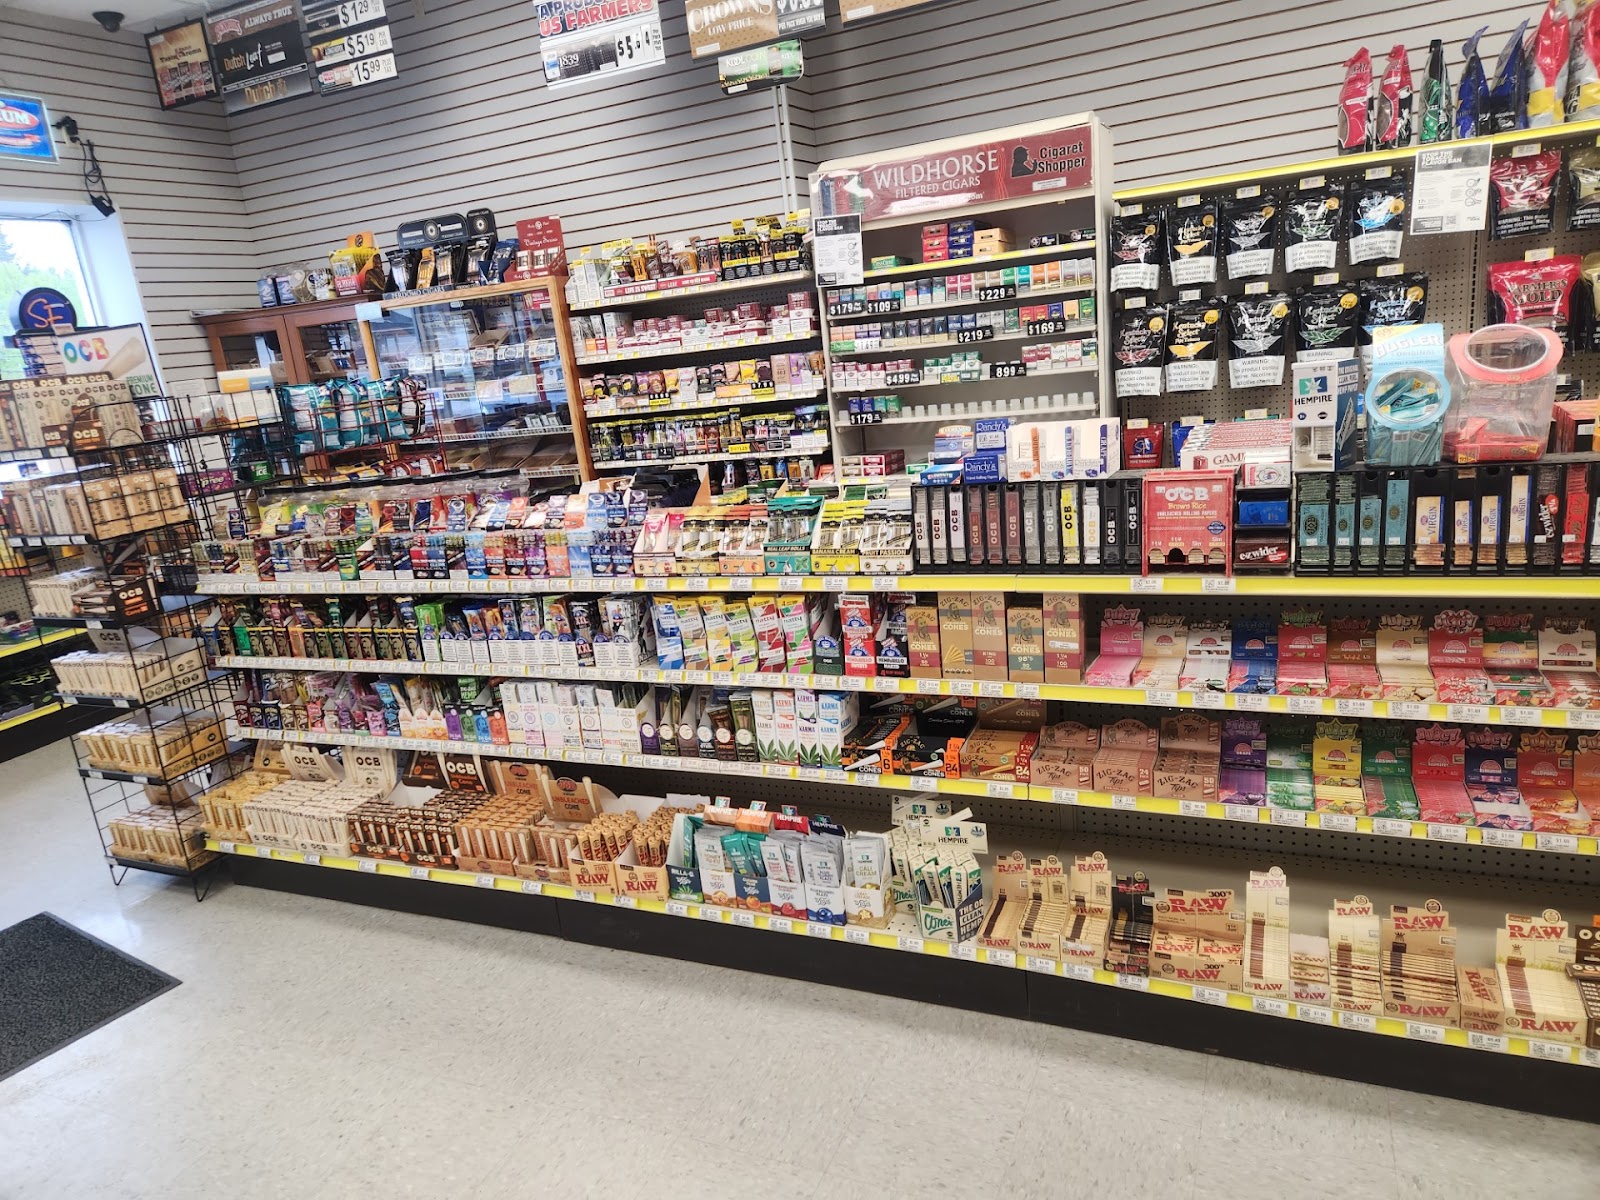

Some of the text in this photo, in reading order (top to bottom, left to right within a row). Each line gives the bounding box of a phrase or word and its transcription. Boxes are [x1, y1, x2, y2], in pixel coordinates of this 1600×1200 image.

[244, 15, 272, 28] ALWAYS
[272, 5, 293, 20] TRUE
[540, 0, 653, 36] US FARMERS
[689, 0, 773, 32] CROWNS
[708, 17, 754, 36] LOW PRICE
[224, 54, 247, 72] Dutch
[559, 54, 579, 69] 1839
[245, 82, 275, 104] Dutch
[1039, 141, 1085, 166] Cigaret
[1422, 150, 1453, 160] STOP THE
[872, 150, 1000, 188] WILDHORSE
[1037, 156, 1087, 182] Shopper
[1420, 158, 1462, 170] FLAVOR BAN
[894, 182, 942, 205] FILTERED
[941, 174, 982, 198] CIGARS
[1512, 290, 1563, 306] GOLD
[64, 337, 110, 364] OCB
[12, 374, 109, 390] OCB OCB OCB
[33, 383, 127, 399] OCB OCB OCB OCB
[1294, 395, 1333, 406] HEMPIRE
[976, 421, 1007, 433] Randy's
[72, 428, 100, 440] OCB
[964, 460, 997, 474] Randy's
[1165, 485, 1210, 501] OCB
[1168, 501, 1207, 513] Brown Rice
[1517, 497, 1526, 522] VIRGIN
[1026, 511, 1034, 533] OCB
[1065, 505, 1073, 529] OCB
[1129, 506, 1137, 530] OCB
[1428, 506, 1437, 535] VIRGIN
[1488, 508, 1496, 533] VIRGIN
[972, 525, 980, 544] OCB
[990, 522, 998, 544] OCB
[1088, 520, 1096, 543] OCB
[1107, 520, 1115, 544] OCB
[813, 552, 833, 560] BANANA
[861, 552, 906, 562] FRUIT PASSION
[119, 587, 144, 600] OCB
[939, 595, 970, 608] ZIG-ZAG
[972, 595, 1003, 608] ZIG-ZAG
[1045, 595, 1077, 608] ZIG-ZAG
[907, 611, 935, 623] ZIG-ZAG
[1010, 612, 1041, 624] ZIG-ZAG
[942, 624, 969, 632] CONES
[974, 629, 1003, 638] CONES
[1046, 630, 1076, 638] CONES
[98, 632, 122, 645] OCB
[577, 644, 592, 654] XXL
[910, 643, 937, 652] CONES
[1011, 646, 1040, 655] CONES
[950, 709, 973, 717] CONES
[1115, 720, 1146, 731] ZIG-ZAG
[1176, 713, 1208, 726] ZIG-ZAG
[1054, 722, 1085, 732] ZIG-ZAG
[1183, 723, 1199, 735] Tips
[1064, 730, 1077, 739] Tips
[1123, 729, 1137, 738] Tips
[900, 740, 925, 750] ZIG-ZAG
[294, 755, 317, 766] OCB
[356, 756, 381, 767] OCB
[883, 760, 891, 771] 6
[961, 755, 990, 766] ZIG-ZAG
[446, 761, 477, 776] OCB
[858, 766, 883, 776] CONES
[923, 770, 945, 778] CONES
[945, 763, 958, 773] 24
[1015, 765, 1030, 777] 24
[1035, 764, 1072, 779] ZIG-ZAG
[1139, 768, 1149, 776] 24
[993, 773, 1016, 782] CONES
[1047, 773, 1061, 781] Tips
[1096, 767, 1135, 782] ZIG-ZAG
[1109, 775, 1124, 787] Tips
[1157, 775, 1199, 790] ZIG-ZAG
[516, 788, 532, 796] CONE
[1171, 783, 1186, 793] Tips
[564, 803, 581, 812] CONE
[776, 813, 804, 825] HEMPIRE
[811, 820, 839, 831] HEMPIRE
[262, 834, 280, 843] OCB
[938, 836, 969, 848] HEMPIRE
[310, 843, 329, 852] OCB
[366, 845, 384, 855] OCB
[416, 853, 436, 863] OCB
[998, 863, 1025, 873] RAW
[1033, 866, 1062, 876] RAW
[1078, 863, 1106, 872] RAW
[575, 873, 609, 885] RAW
[1250, 878, 1286, 890] RAW
[624, 880, 657, 892] RAW
[1117, 882, 1149, 893] RAW
[1207, 889, 1232, 899] 300's
[958, 904, 975, 917] THE
[1080, 907, 1105, 916] RAW
[1168, 897, 1229, 914] RAW
[1335, 905, 1371, 918] RAW
[962, 909, 983, 925] CLEAN
[1392, 915, 1448, 931] RAW
[960, 918, 983, 936] HEMP
[1507, 923, 1567, 941] RAW
[985, 938, 1010, 948] RAW
[1027, 941, 1052, 951] RAW
[1155, 943, 1195, 953] RAW
[1071, 948, 1096, 958] RAW
[1203, 945, 1243, 956] RAW
[1292, 955, 1326, 965] RAW
[1113, 964, 1139, 975] RAW
[1176, 968, 1223, 981] RAW
[1292, 971, 1325, 980] RAW
[1252, 983, 1283, 992] RAW
[1464, 969, 1491, 1002] RAW
[1293, 991, 1327, 1001] RAW
[1341, 1001, 1373, 1012] RAW
[1398, 1003, 1451, 1018] RAW
[1472, 1010, 1501, 1021] RAW
[1472, 1022, 1501, 1033] RAW
[1519, 1017, 1580, 1034] RAW
